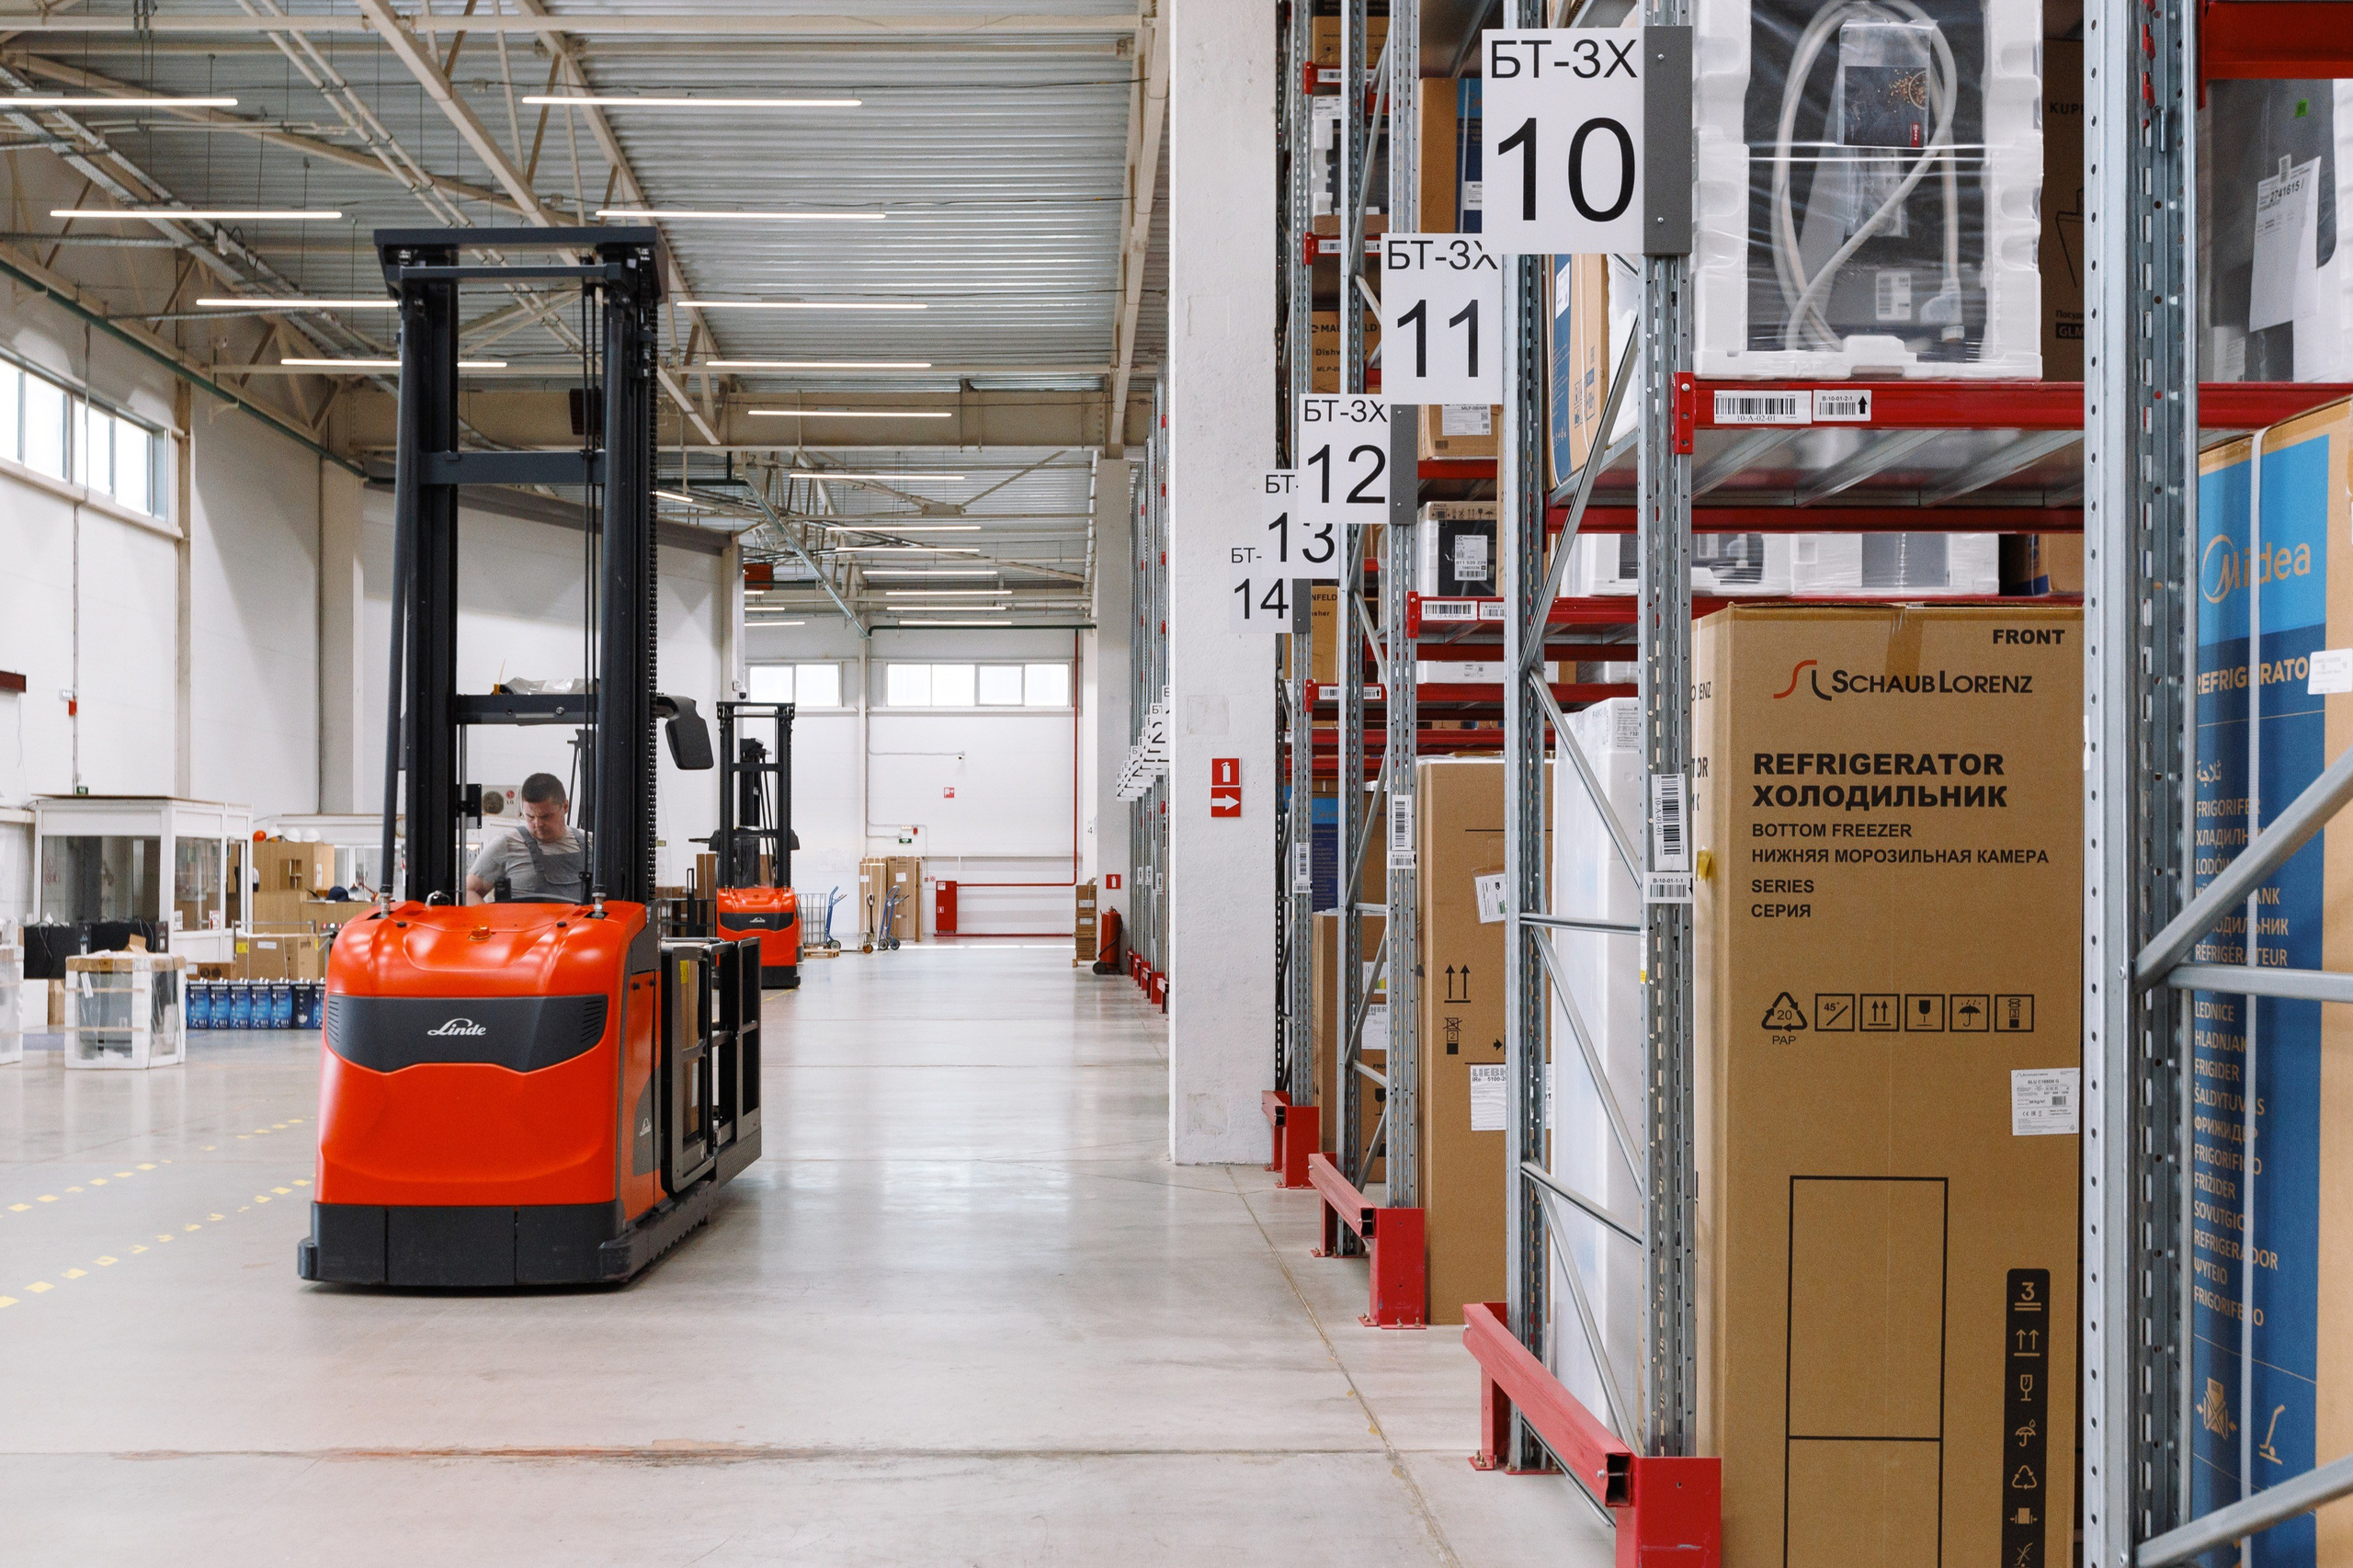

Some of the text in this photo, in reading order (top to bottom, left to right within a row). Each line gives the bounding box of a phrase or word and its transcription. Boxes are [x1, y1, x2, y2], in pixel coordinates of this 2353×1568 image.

[1498, 118, 1636, 222] 10
[1397, 299, 1479, 378] 11
[1307, 444, 1386, 504] 12
[1268, 512, 1336, 563] 13
[1234, 578, 1290, 619] 14
[1993, 630, 2066, 644] FRONT
[1754, 754, 2005, 776] REFRIGERATOR
[1752, 786, 2007, 812] ХОЛОДИЛЬНИК
[1752, 824, 1912, 837] BOTTOM FREEZER
[1752, 849, 2049, 864] НИЖНЯЯ МОРОЗИЛЬНАЯ КАМЕРА
[1751, 880, 1814, 893] SERIES
[1751, 903, 1811, 918] СЕРИЯ
[1777, 1009, 1792, 1021] 20
[2195, 1001, 2234, 1022] LEDNICE
[427, 1017, 486, 1036] Linde
[1772, 1035, 1796, 1045] PAP
[2194, 1058, 2240, 1082] FRIGIDER
[2194, 1082, 2265, 1116] ŠALDYTUVS
[2194, 1142, 2263, 1176] FRIGORÍFIO
[2194, 1171, 2235, 1199] FRIŽIDER
[2194, 1285, 2264, 1326] FRIGORIFEO
